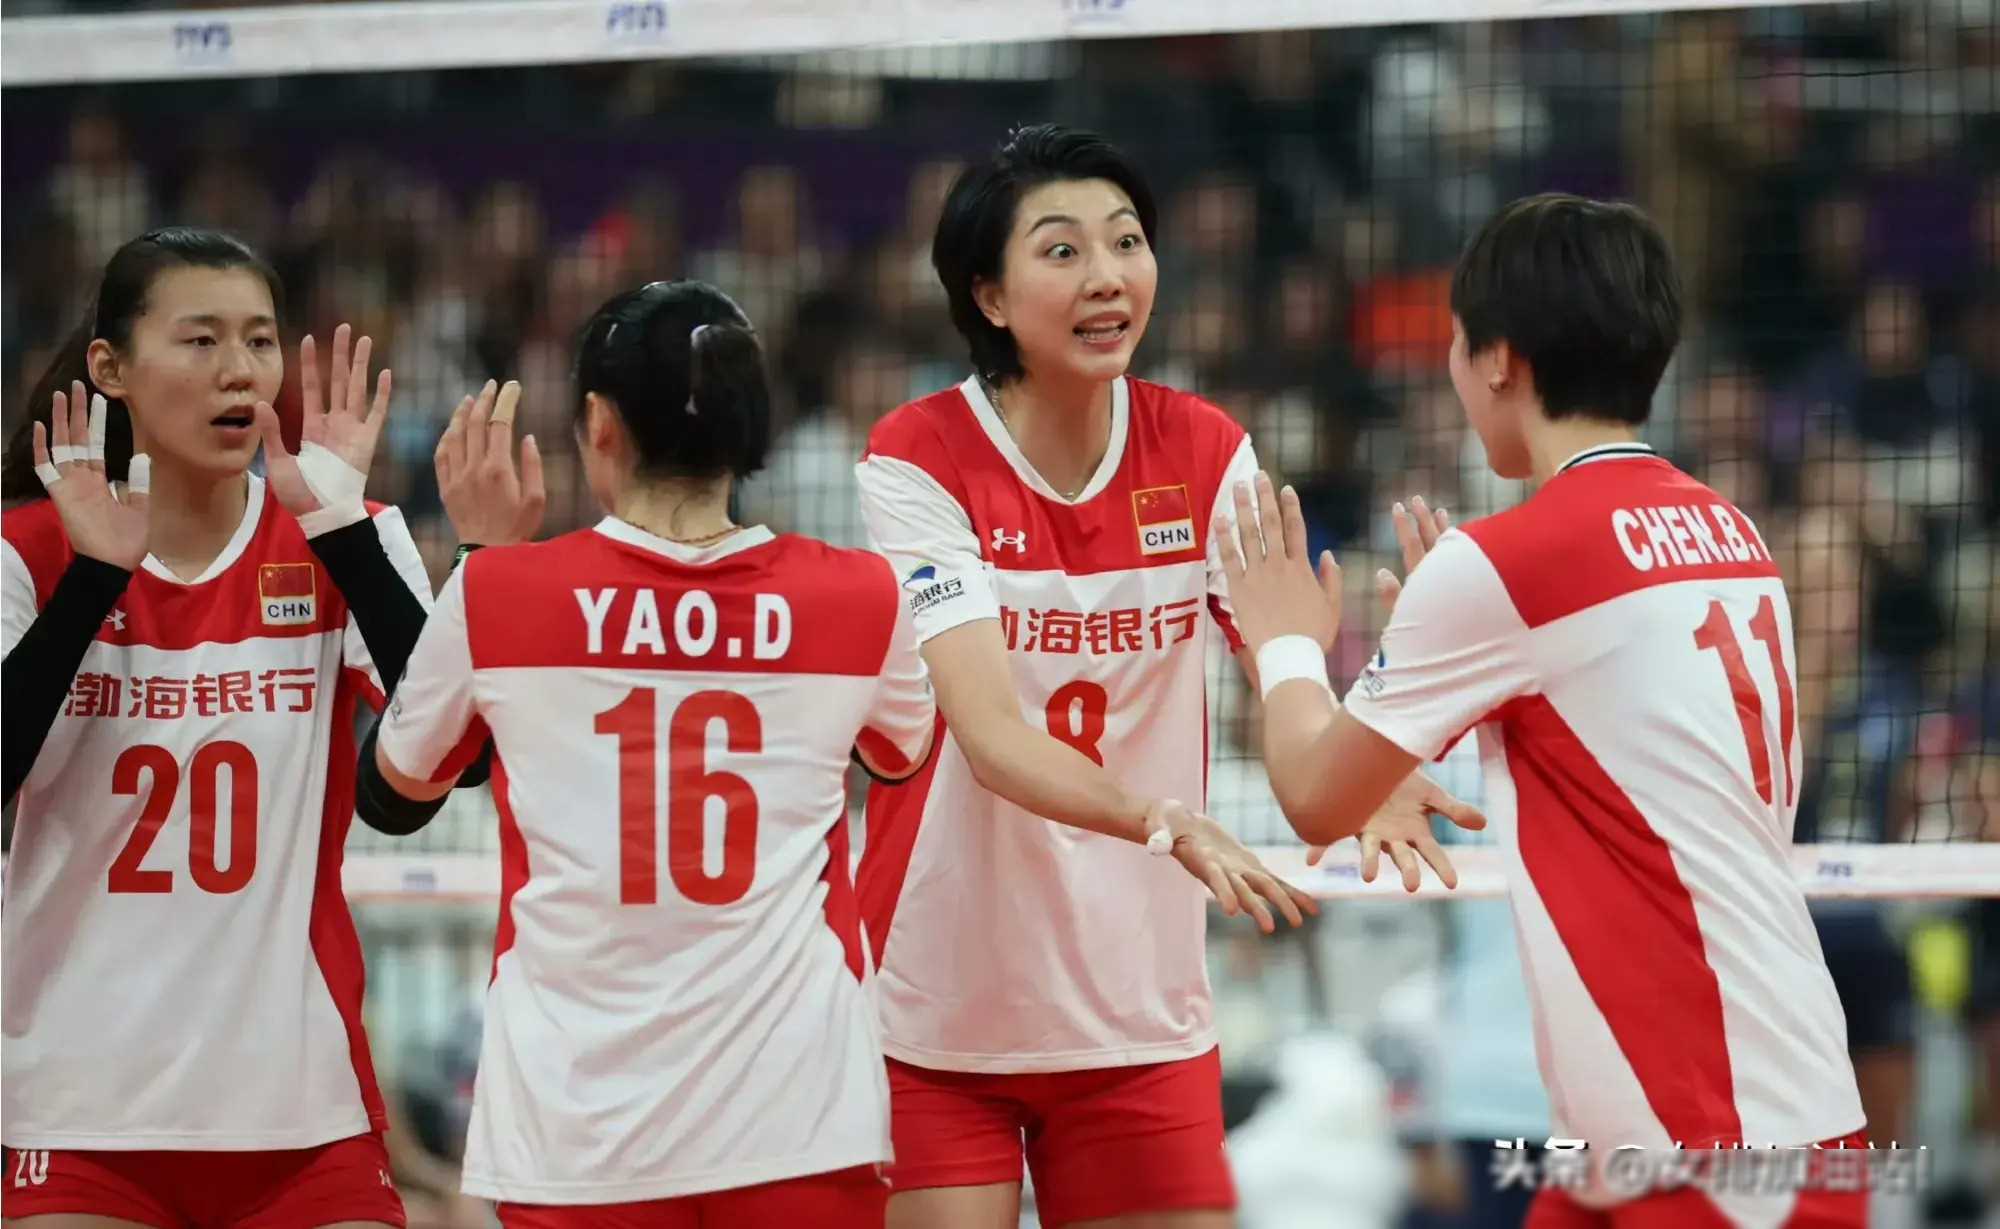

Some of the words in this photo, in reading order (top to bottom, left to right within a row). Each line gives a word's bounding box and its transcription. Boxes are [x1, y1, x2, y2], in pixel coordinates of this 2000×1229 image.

[1145, 527, 1190, 546] CHN
[267, 602, 311, 618] CHN
[573, 588, 792, 660] YAO.D
[64, 668, 315, 720] 渤海银行
[1693, 594, 1794, 807] 11
[108, 740, 258, 893] 20
[594, 687, 763, 906] 16
